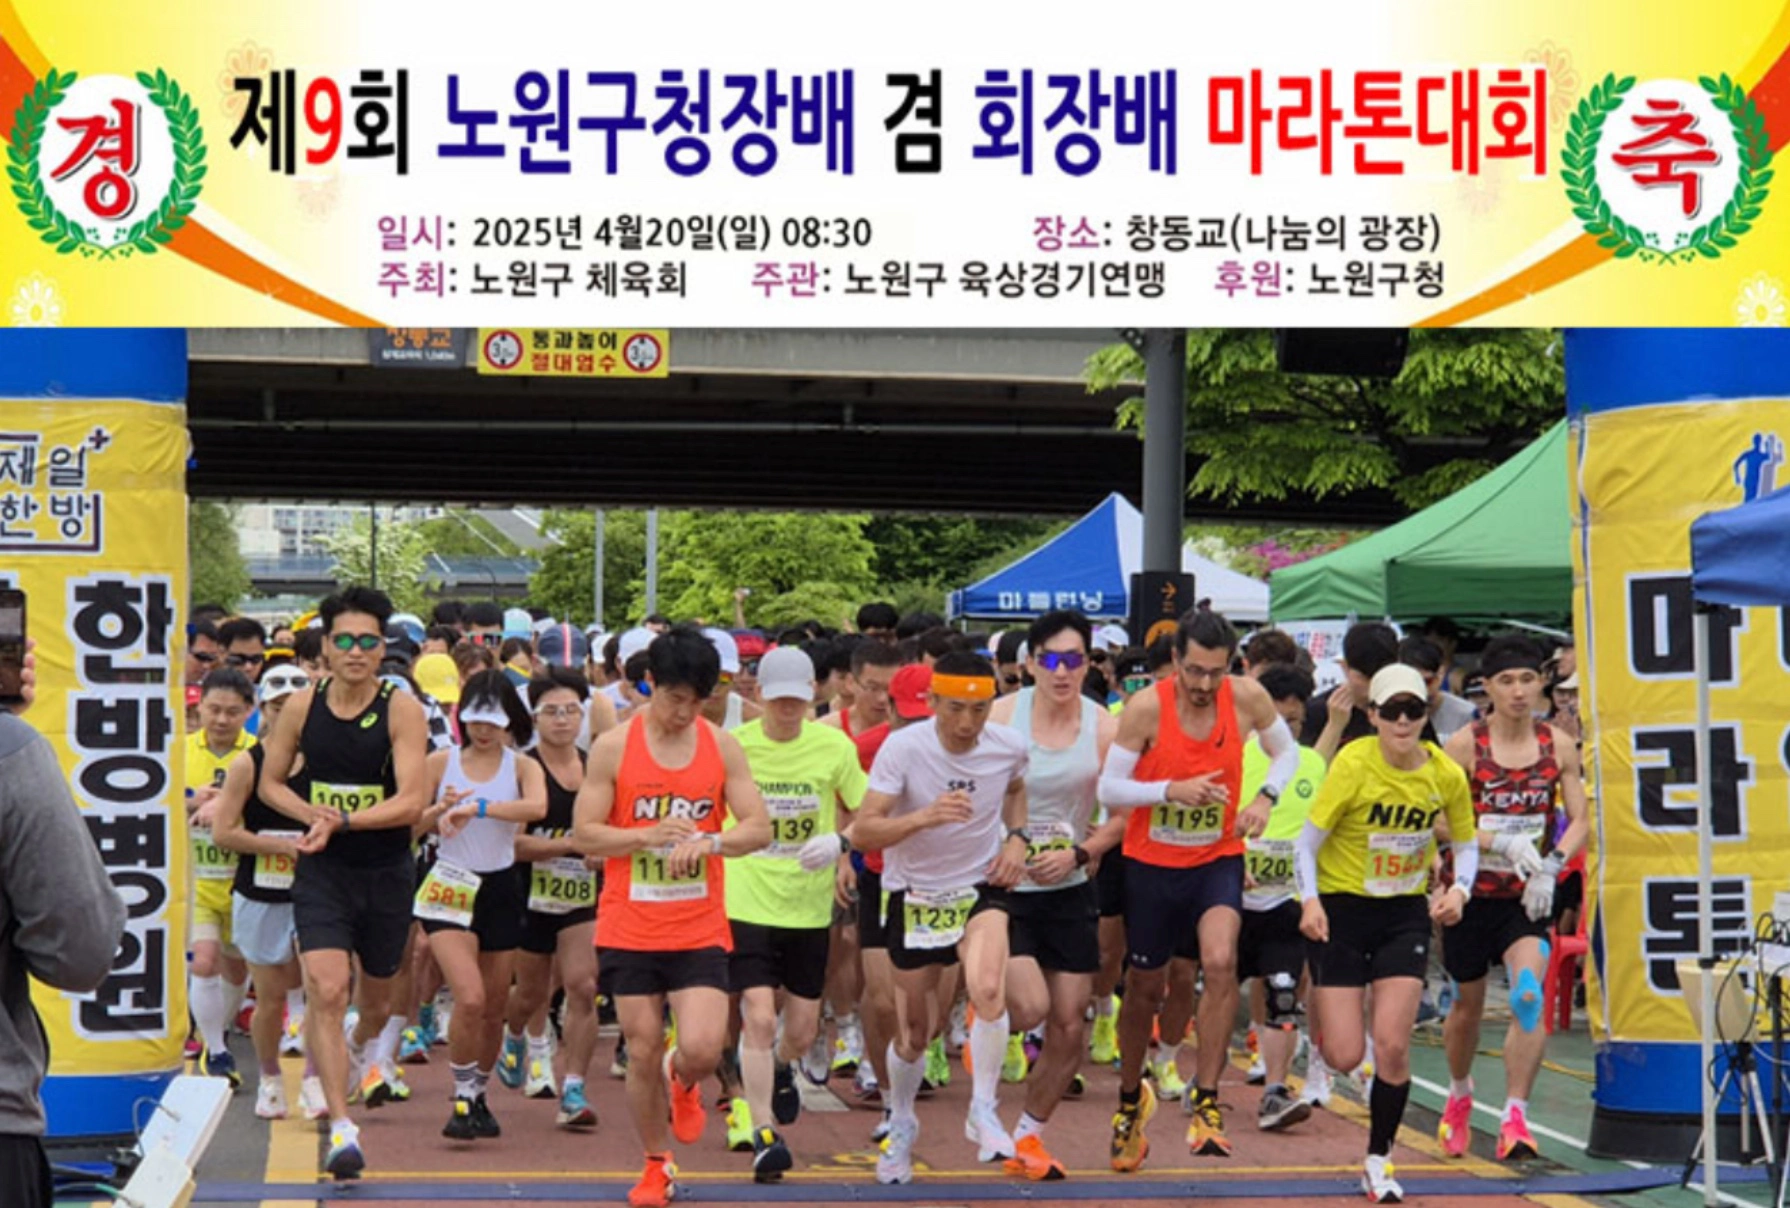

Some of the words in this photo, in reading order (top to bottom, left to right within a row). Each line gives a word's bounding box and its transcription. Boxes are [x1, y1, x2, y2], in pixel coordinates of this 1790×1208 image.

[757, 781, 815, 796] HAMPION
[316, 792, 378, 813] 1092
[1482, 790, 1550, 808] KENYA
[1160, 806, 1219, 829] 1195
[262, 852, 297, 872] 15
[538, 876, 591, 901] 1208
